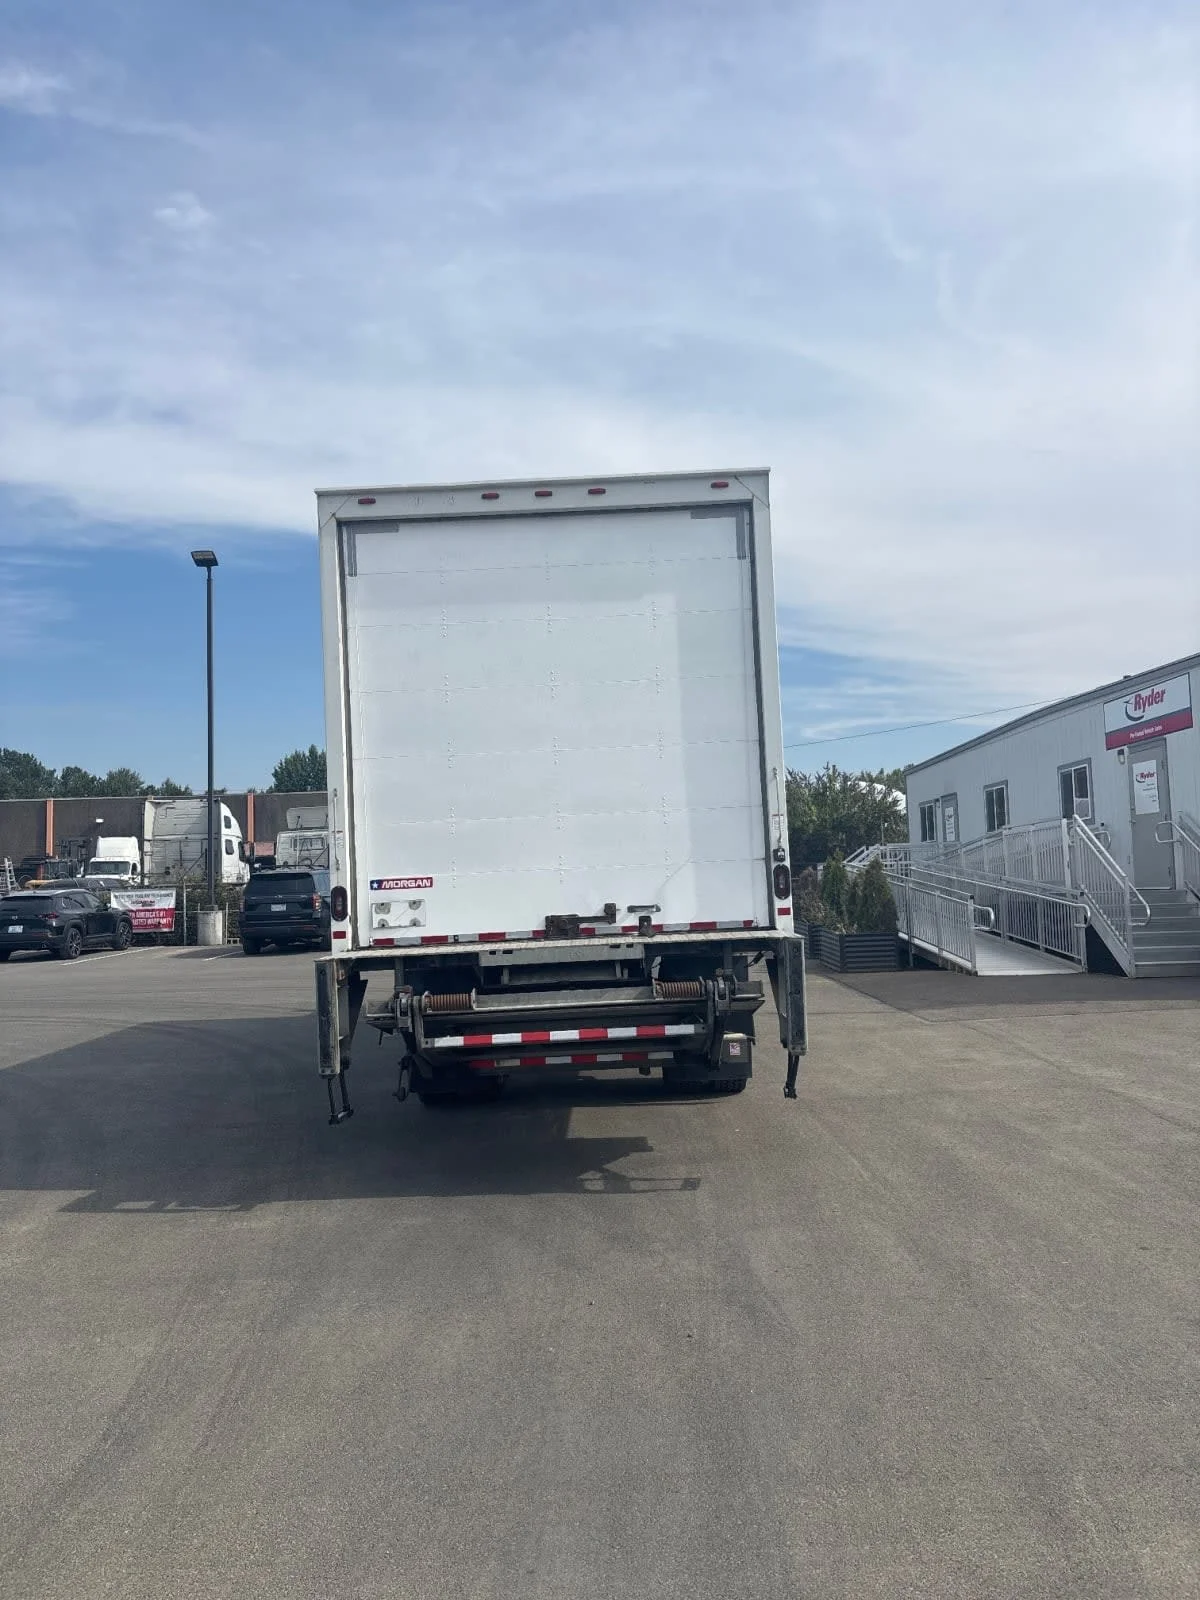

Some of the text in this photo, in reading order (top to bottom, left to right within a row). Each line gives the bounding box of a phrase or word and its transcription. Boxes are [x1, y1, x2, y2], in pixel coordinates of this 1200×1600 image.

[1133, 688, 1166, 713] Ryder
[1140, 771, 1155, 780] Ryder
[381, 879, 431, 889] MORGAN
